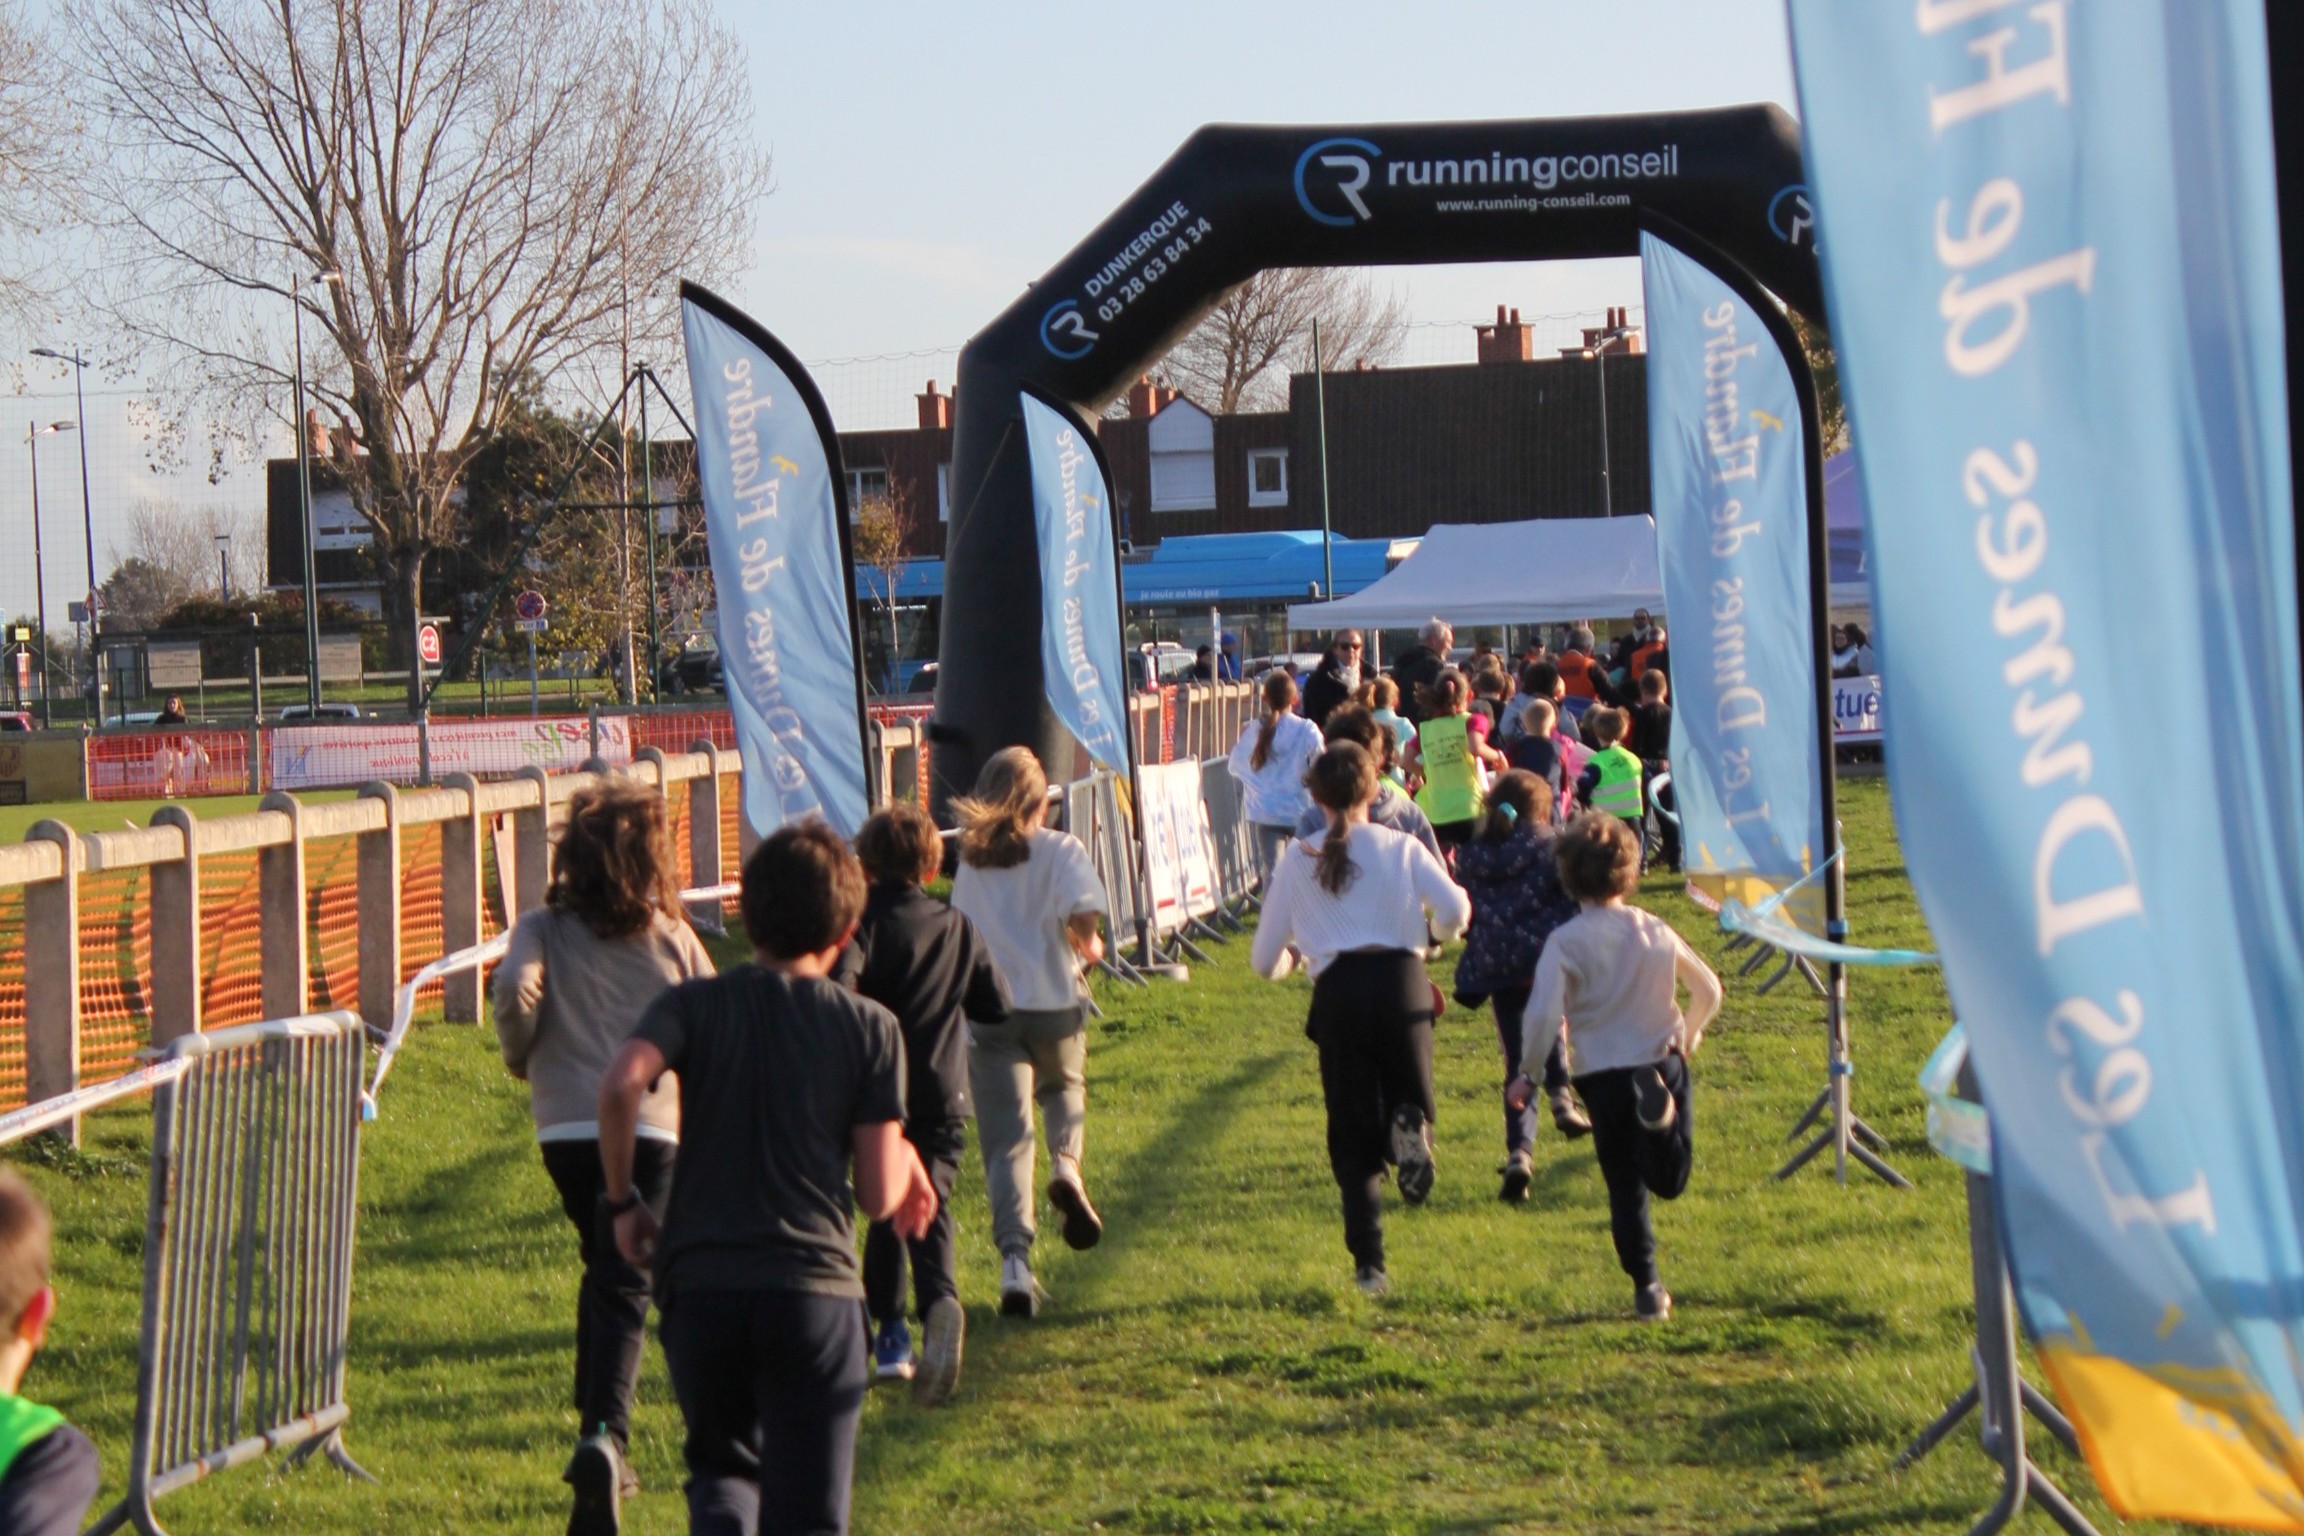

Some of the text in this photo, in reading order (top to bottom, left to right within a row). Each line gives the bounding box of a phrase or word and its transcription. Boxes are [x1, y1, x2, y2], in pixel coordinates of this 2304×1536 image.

[1436, 192, 1631, 213] www.running-conseil.com
[1084, 200, 1190, 298] DUNKERQUE
[1098, 216, 1213, 323] 03 28 63 84 34
[421, 635, 437, 652] C2
